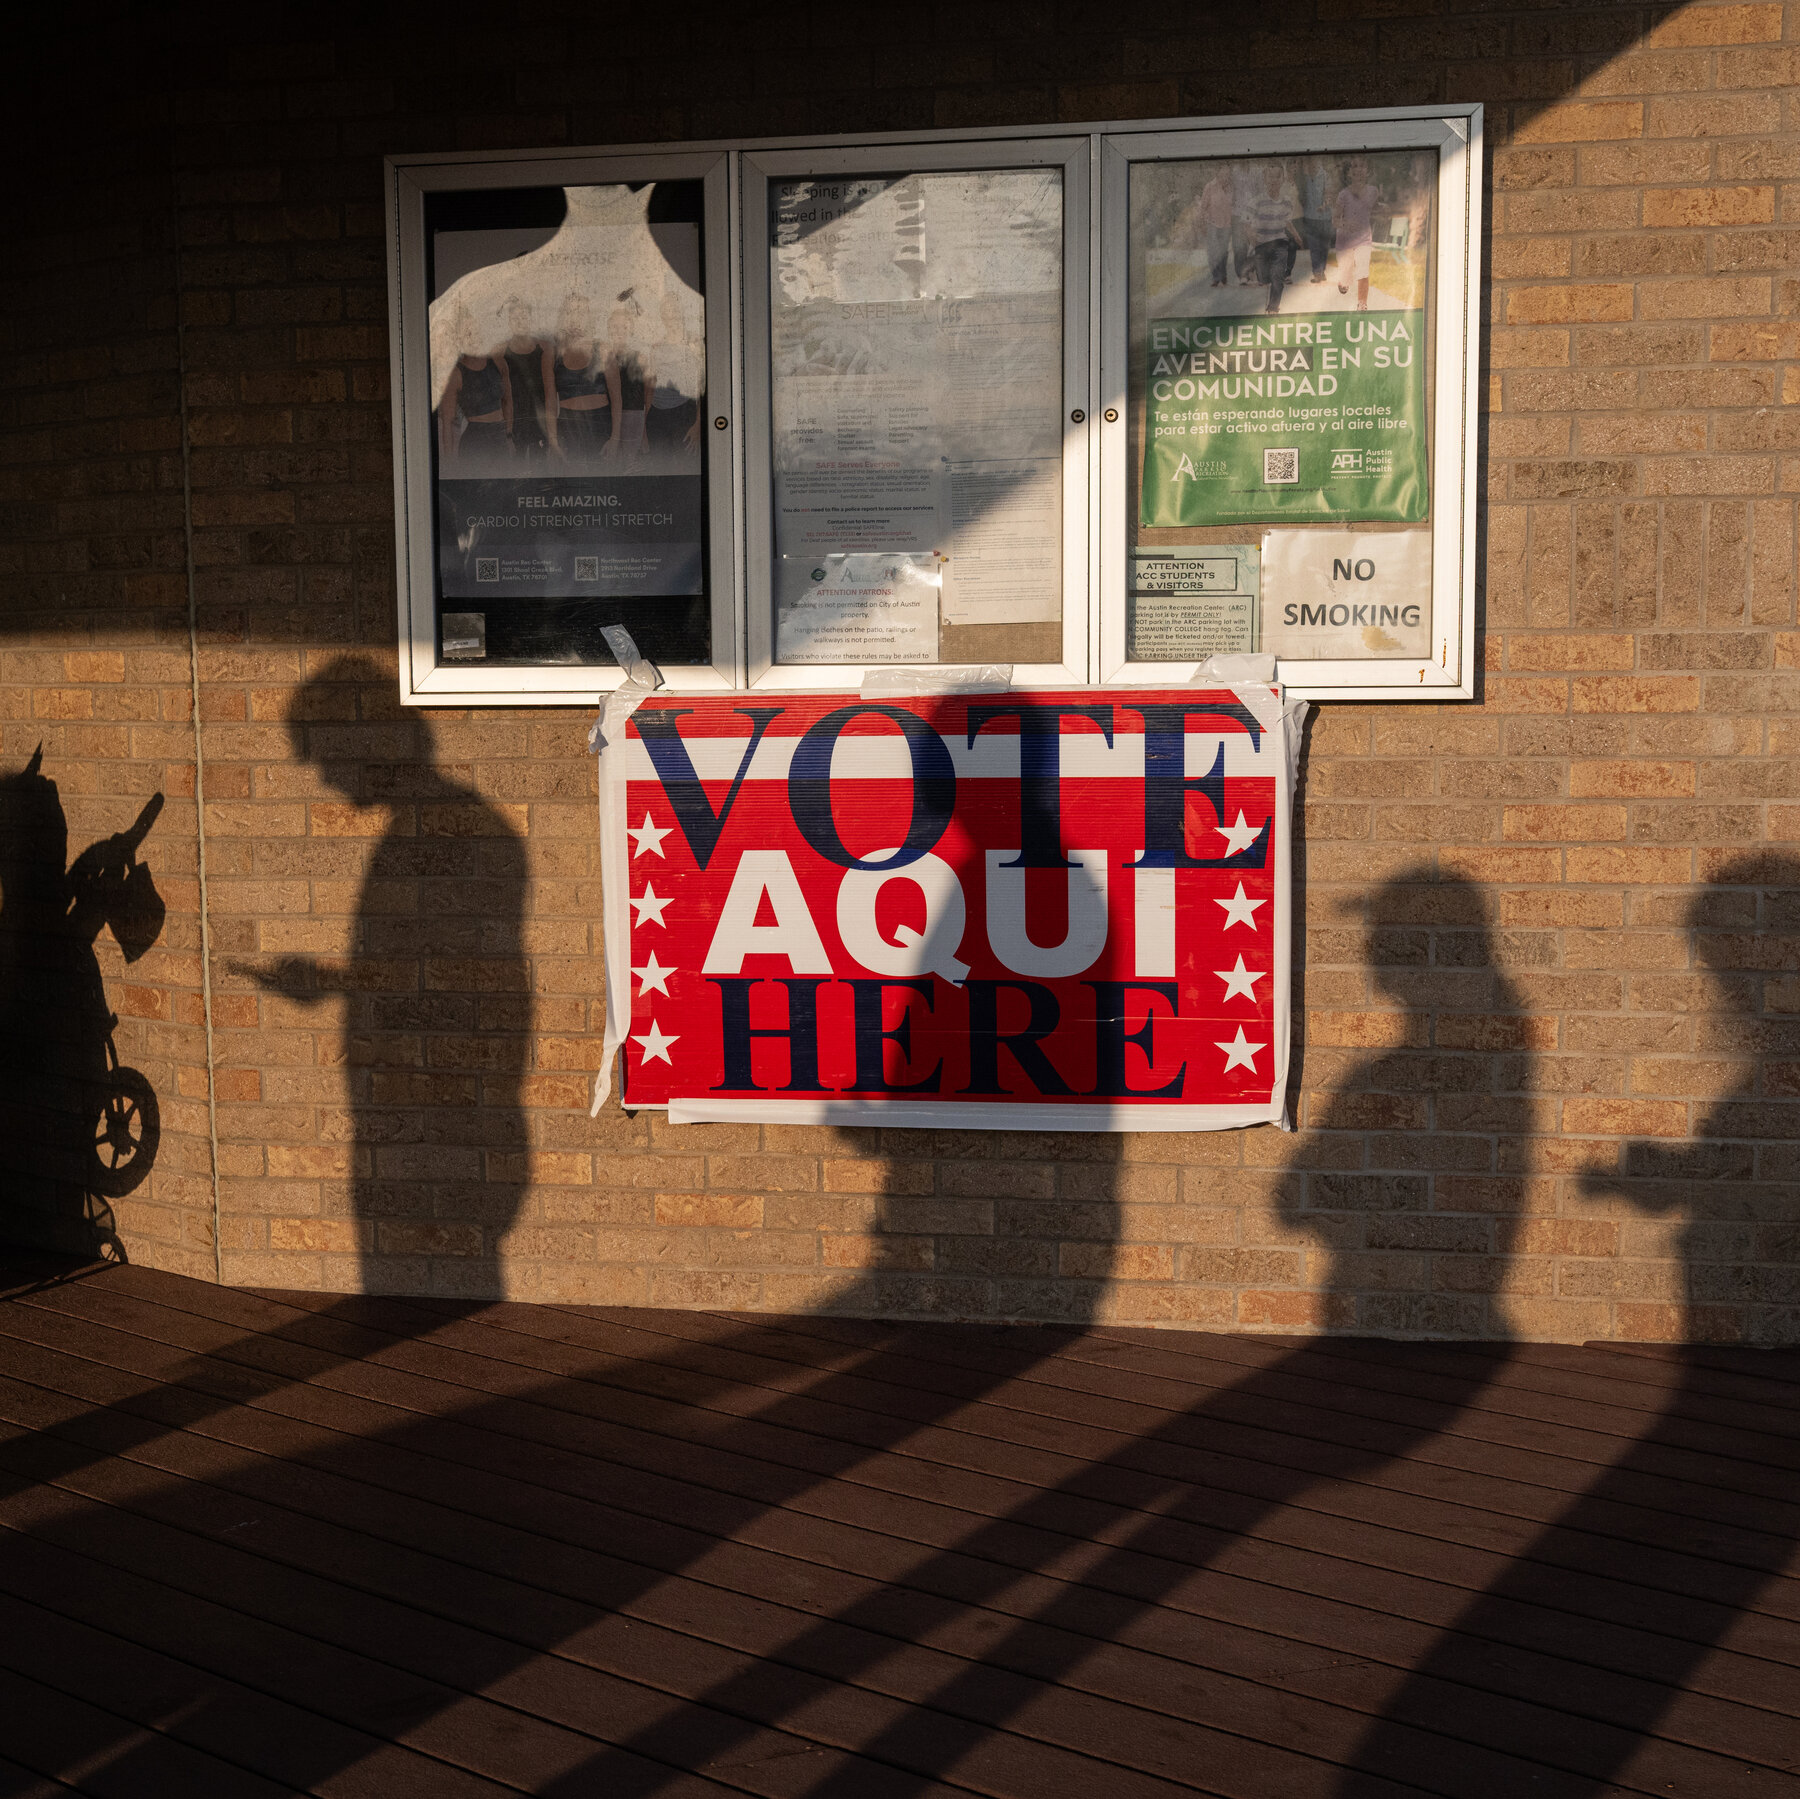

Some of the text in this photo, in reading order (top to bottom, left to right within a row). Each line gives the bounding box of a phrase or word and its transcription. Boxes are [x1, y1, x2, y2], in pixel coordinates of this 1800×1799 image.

[771, 209, 816, 223] llowed
[821, 208, 832, 221] in
[841, 304, 886, 319] SAFE
[1152, 320, 1410, 350] ENCUENTRE UNA
[1152, 346, 1412, 376] AVENTURA EN SU
[1152, 375, 1338, 401] COMUNIDAD
[1154, 404, 1391, 423] Te están esperando lugares locales
[1155, 417, 1408, 438] para estar activo afuera y al aire libre
[1331, 453, 1363, 469] APH
[1366, 465, 1393, 473] Health
[518, 495, 622, 508] FEEL AMAZING.
[466, 513, 673, 528] CARDIO STRENGTH STRETCH
[1146, 562, 1205, 570] ATTENTION
[1333, 558, 1376, 581] NO
[1136, 572, 1157, 580] ACC
[879, 601, 891, 609] City
[1228, 604, 1247, 612] (ARC)
[1283, 604, 1420, 627] SMOKING
[863, 636, 896, 644] permitted.
[632, 704, 1272, 870] VOTE
[702, 848, 1176, 988] AQUI
[705, 979, 1187, 1098] HERE
